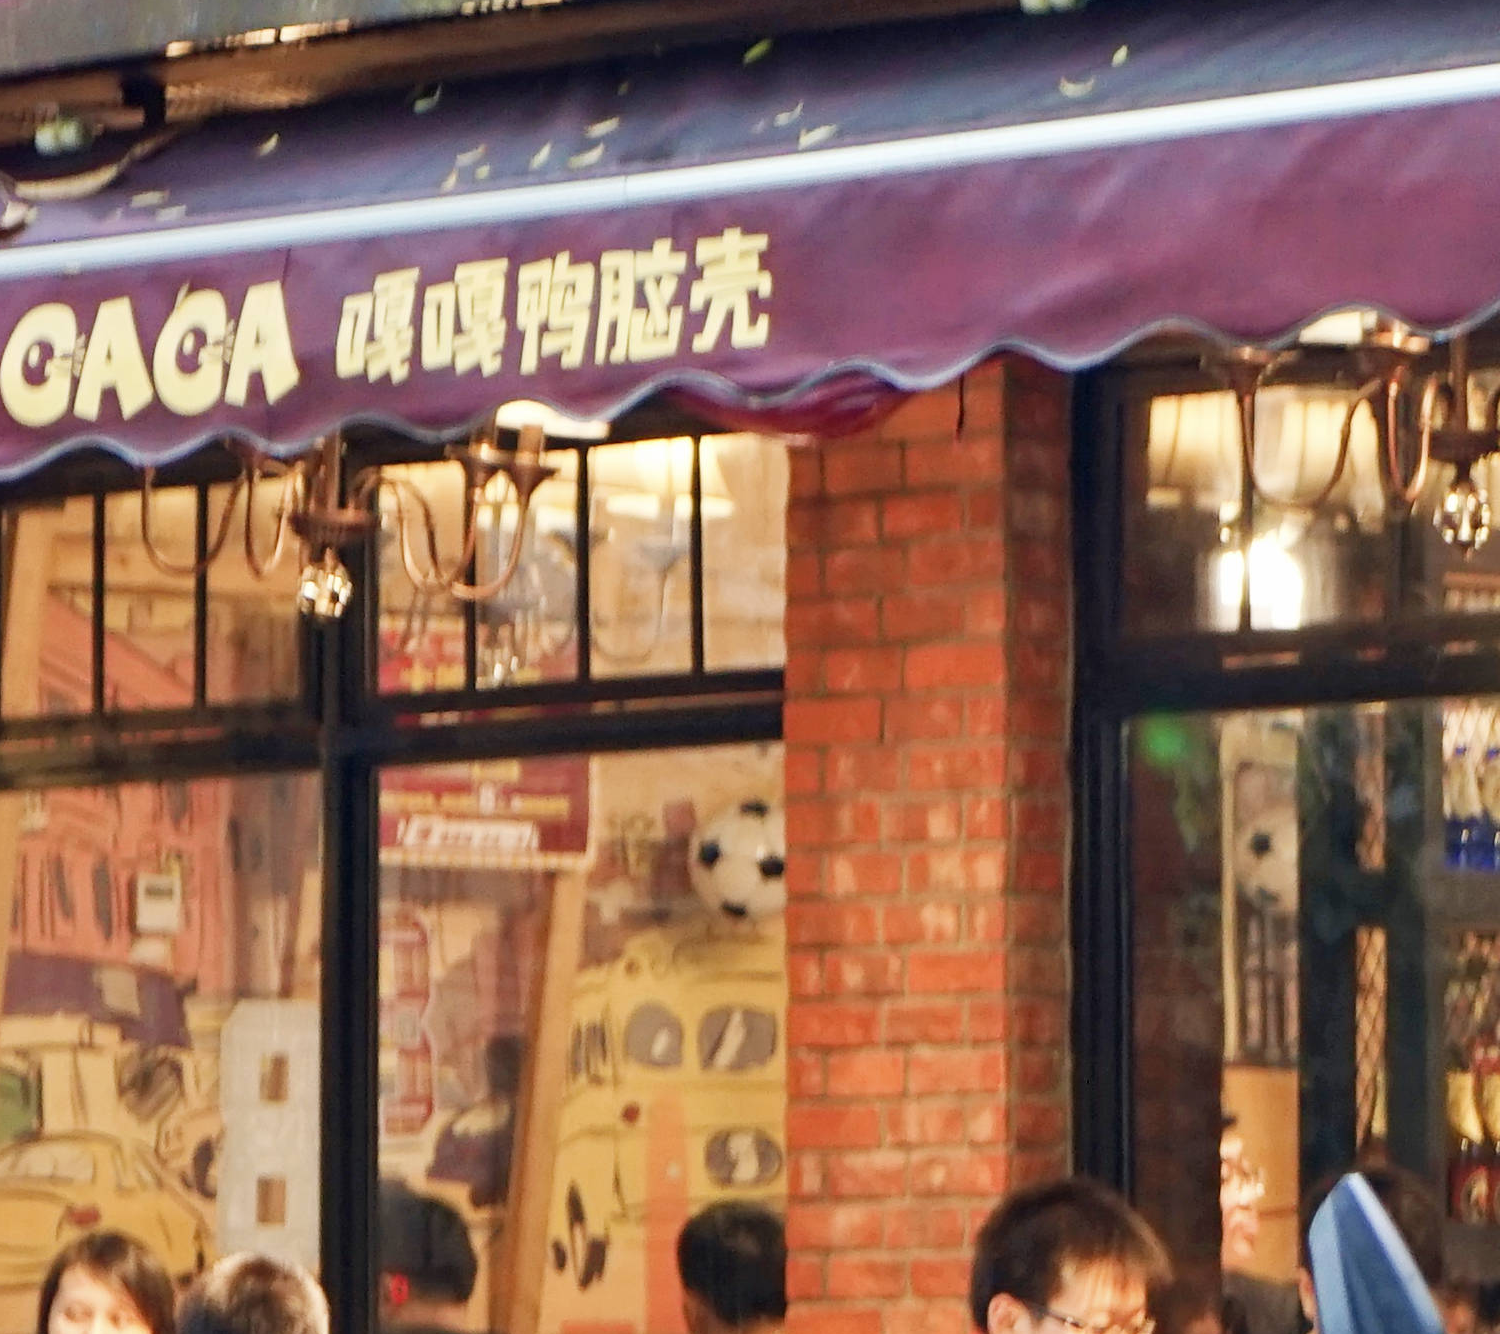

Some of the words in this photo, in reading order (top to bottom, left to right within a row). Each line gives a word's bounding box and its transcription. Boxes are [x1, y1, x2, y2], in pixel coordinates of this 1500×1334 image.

[0, 279, 300, 428] GAGA
[336, 226, 771, 385] 嘎嘎鸭脑壳
